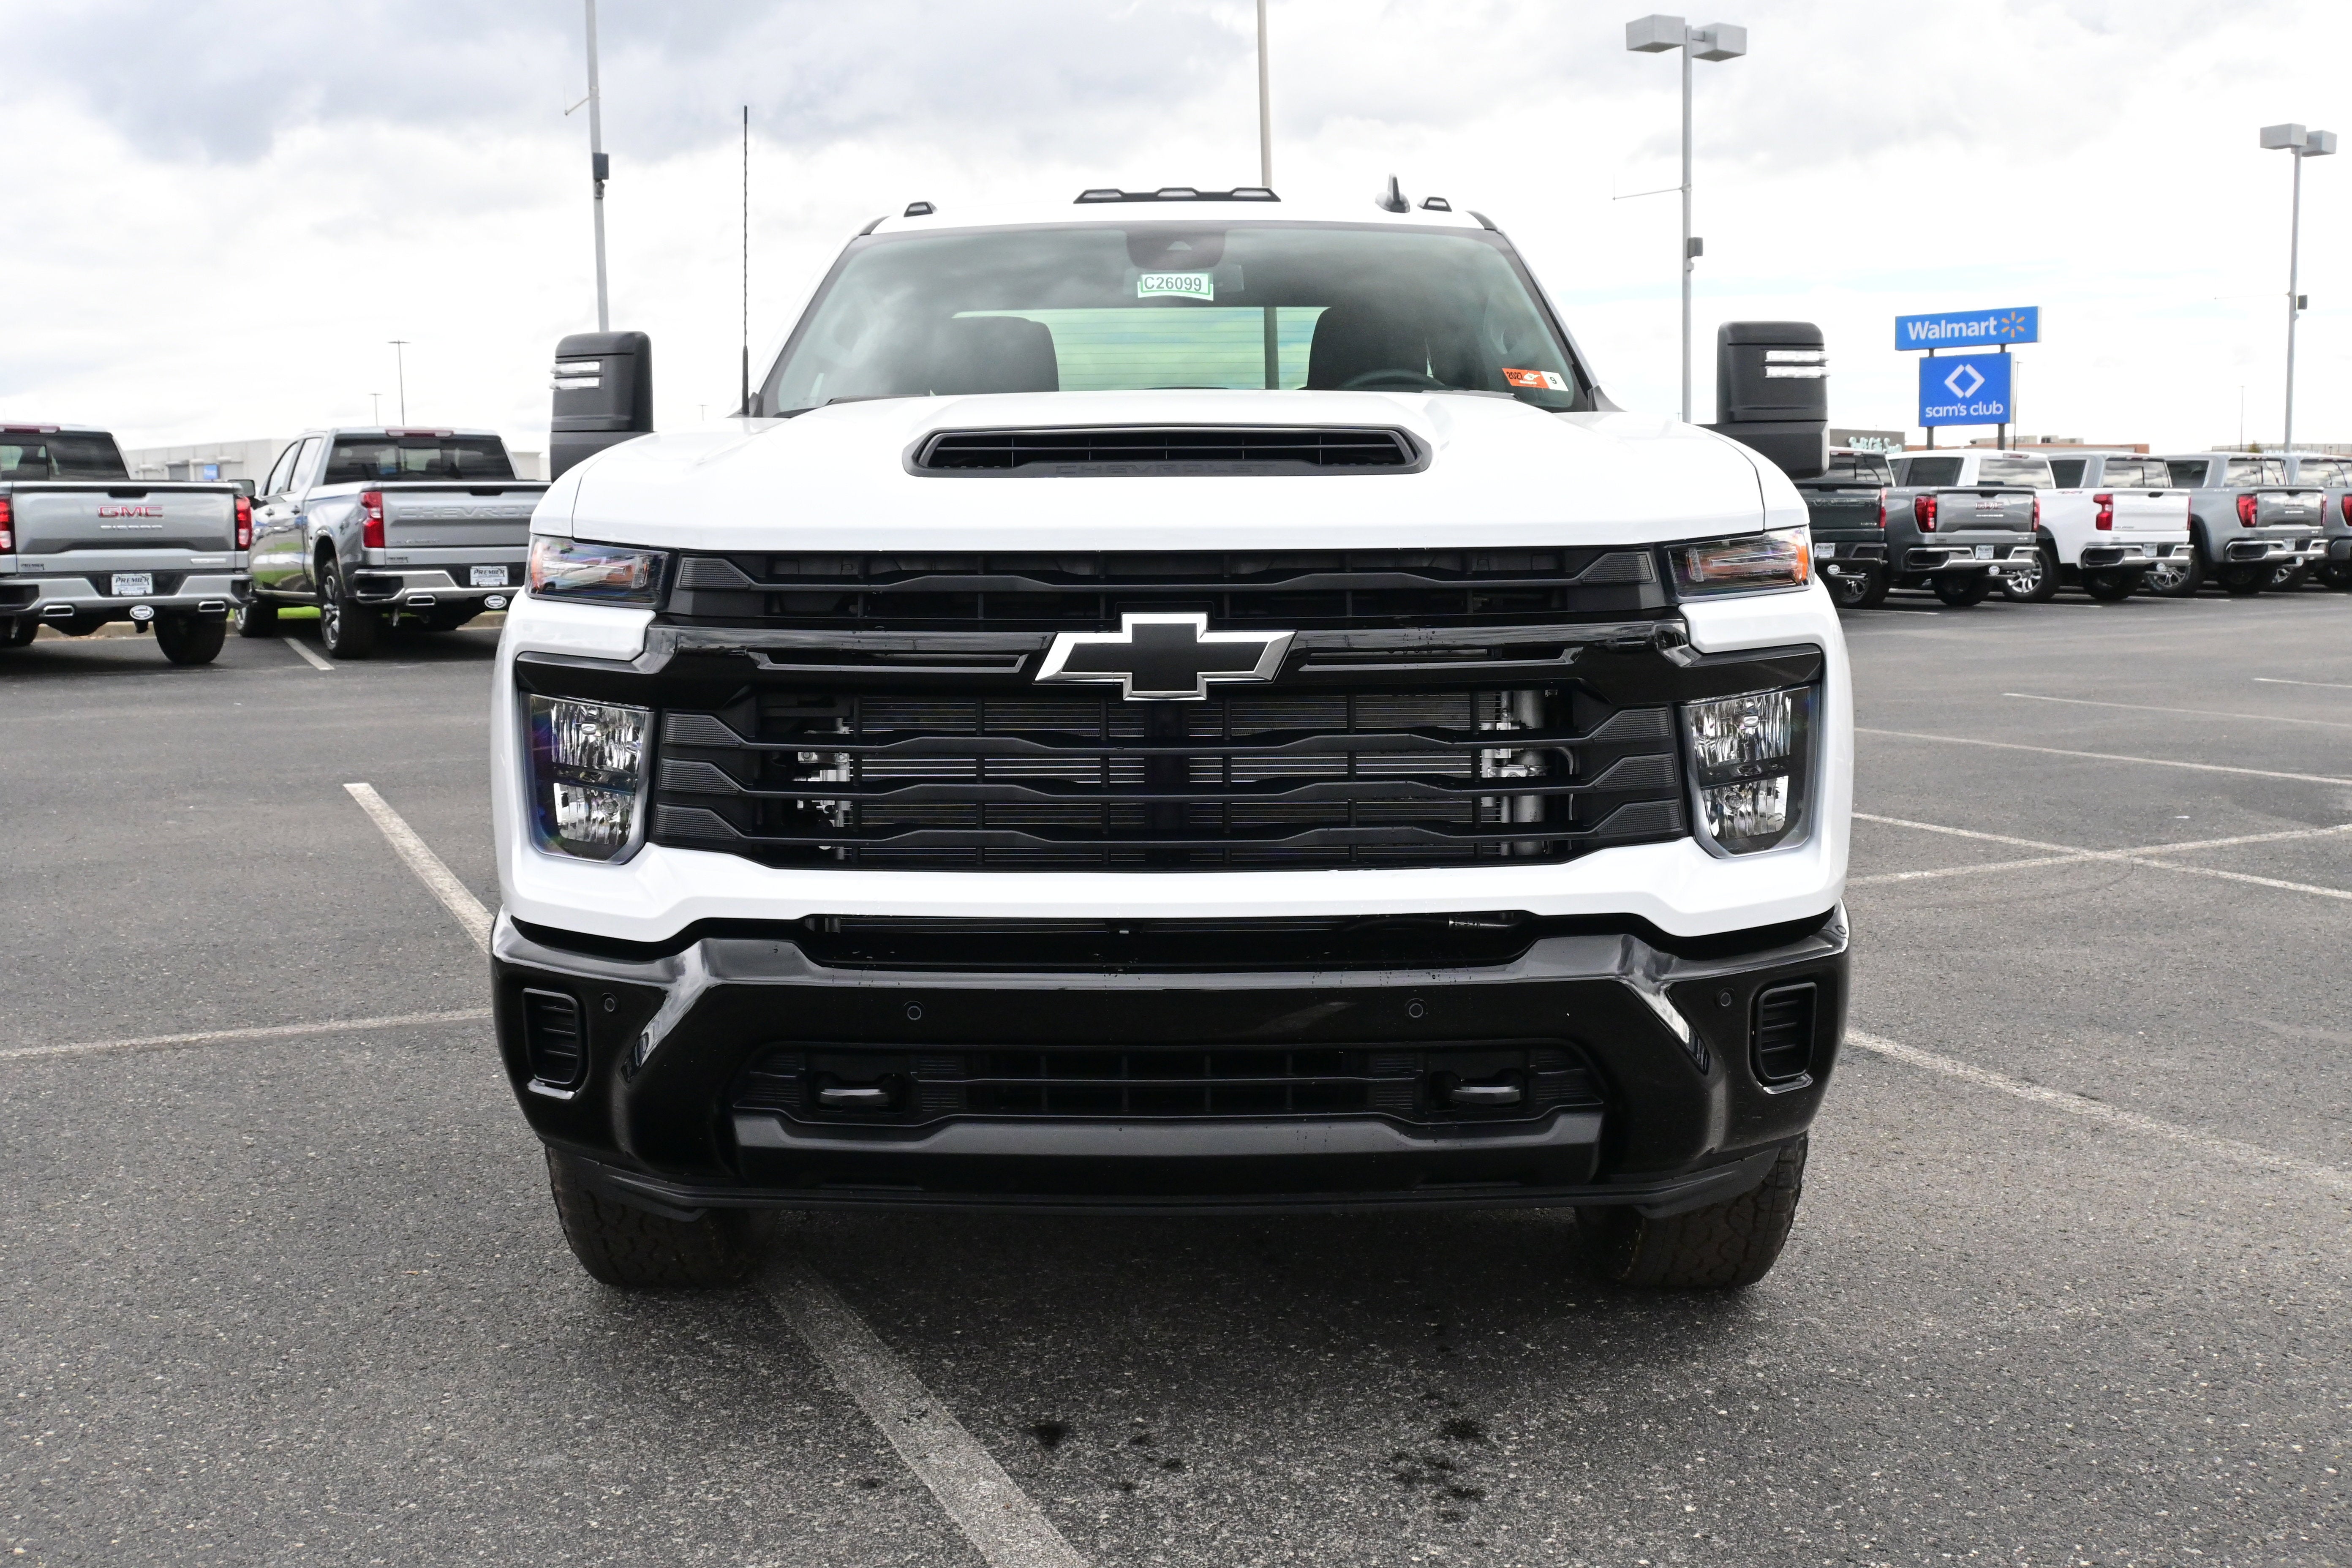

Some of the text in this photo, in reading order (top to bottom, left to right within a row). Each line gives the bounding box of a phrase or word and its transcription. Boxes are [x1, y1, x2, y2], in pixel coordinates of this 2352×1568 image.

[1144, 276, 1202, 291] C26099
[1907, 316, 1997, 340] Walmart
[1506, 371, 1557, 384] 2027 9
[1925, 400, 2004, 418] sam's club
[98, 506, 163, 518] GMC
[398, 506, 533, 517] CHEVROL
[474, 568, 505, 577] PREMIER
[115, 576, 149, 585] PREMIER
